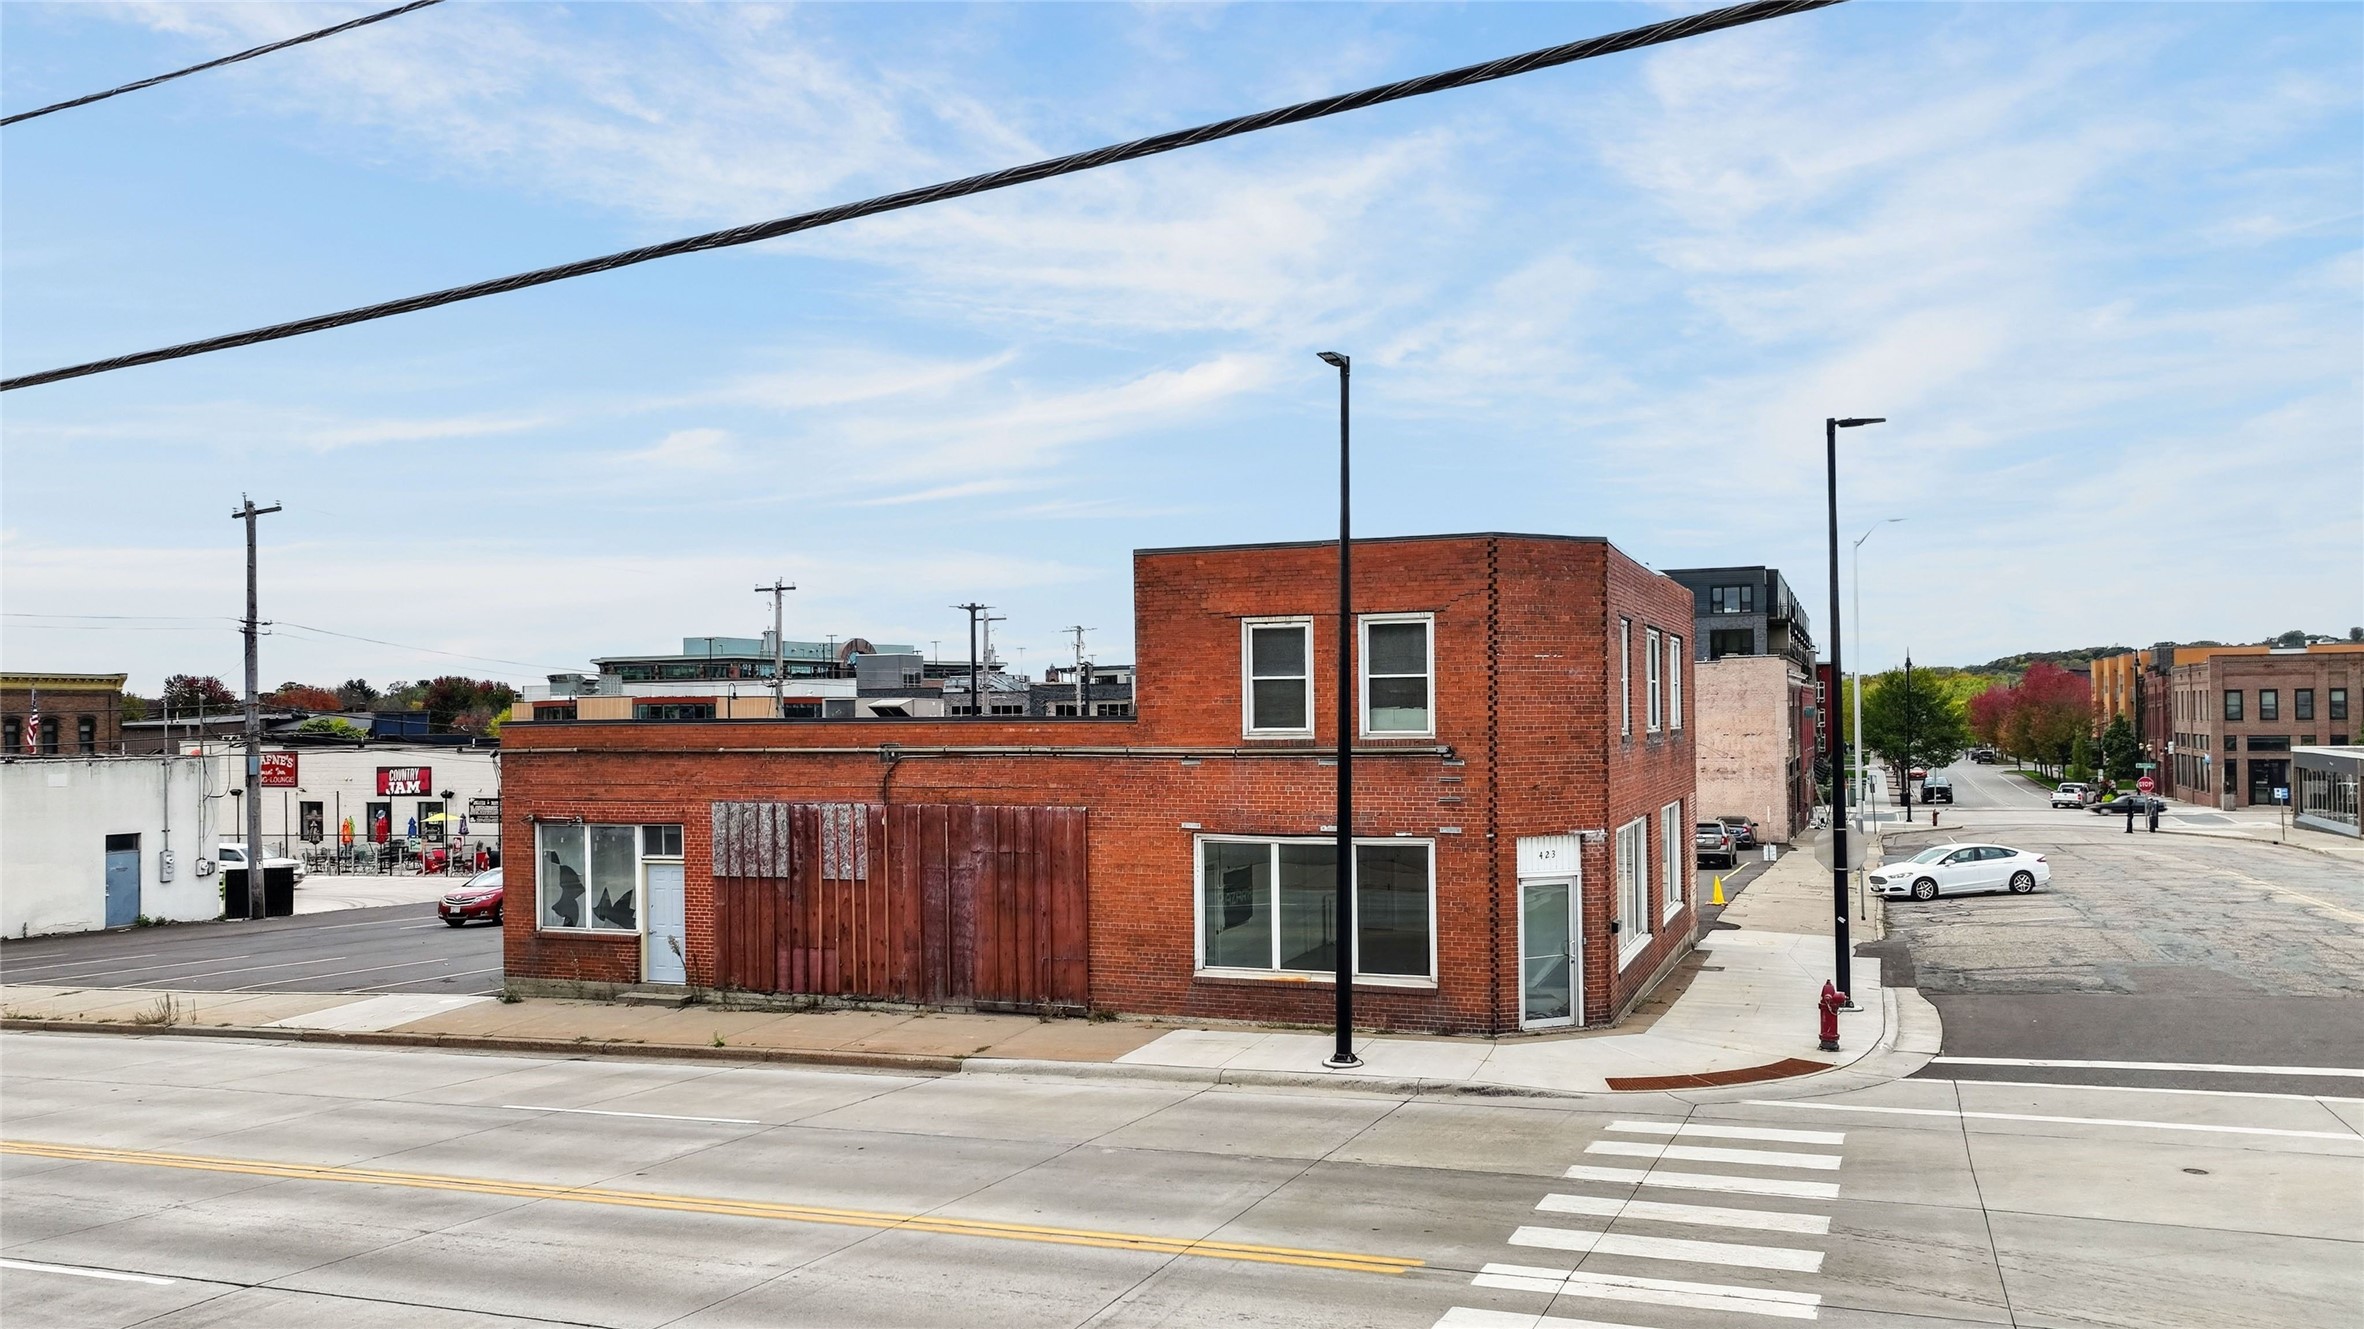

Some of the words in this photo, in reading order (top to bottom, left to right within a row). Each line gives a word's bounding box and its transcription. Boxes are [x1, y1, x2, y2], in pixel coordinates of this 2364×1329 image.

[389, 767, 419, 781] COUNTRY
[385, 781, 420, 795] JAM
[1539, 850, 1556, 859] 423
